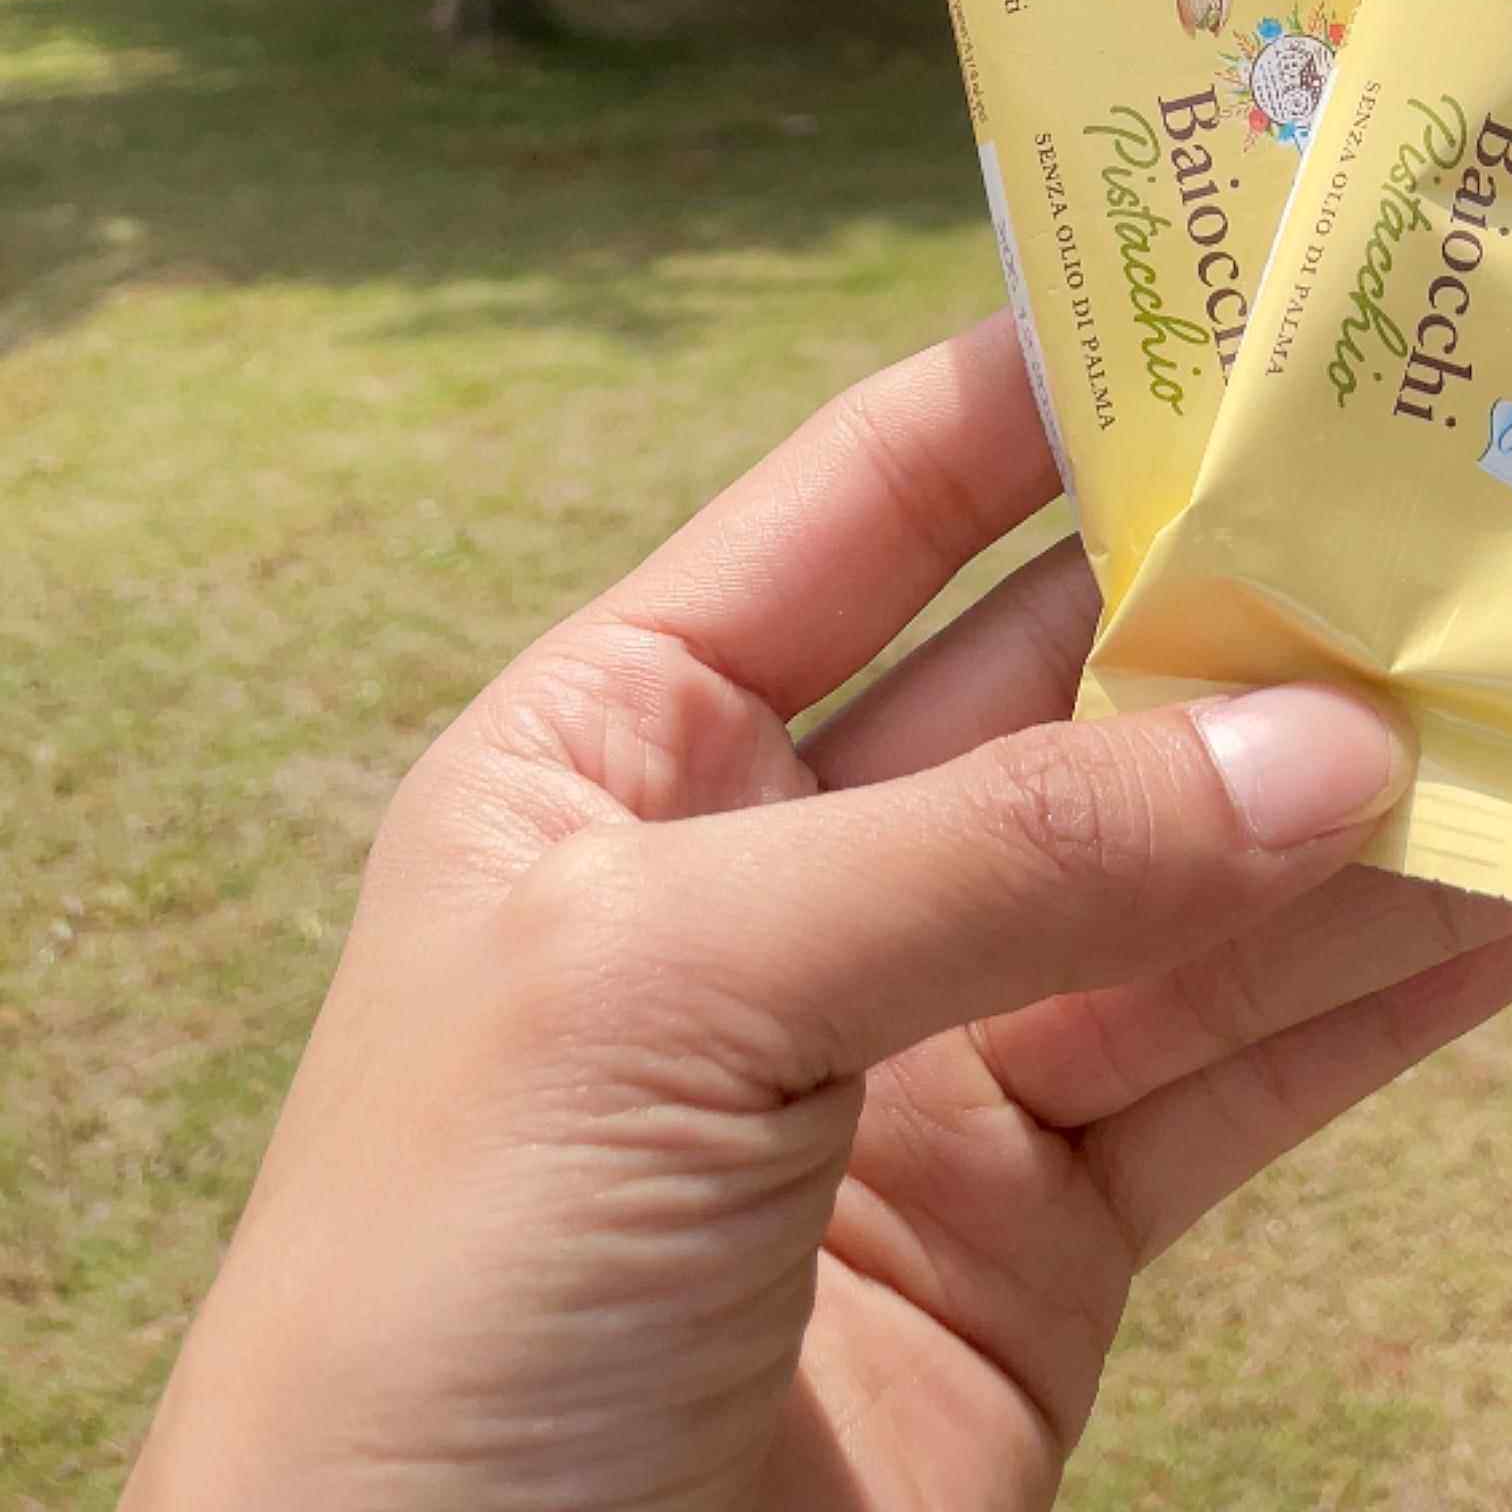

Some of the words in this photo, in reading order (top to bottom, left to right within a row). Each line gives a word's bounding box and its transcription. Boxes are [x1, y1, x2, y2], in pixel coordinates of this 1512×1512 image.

[1340, 79, 1382, 163] SENZA
[1034, 133, 1068, 221] SENZA
[1315, 172, 1350, 236] OLIO
[1056, 224, 1084, 289] OLIO
[1083, 104, 1210, 416] Pistacchio
[1157, 83, 1249, 386] Baiocc
[1300, 245, 1326, 275] DI
[1328, 94, 1468, 408] Pistacchio
[1072, 296, 1095, 331] DI
[1265, 283, 1312, 376] PALMA
[1081, 335, 1116, 431] PALMA
